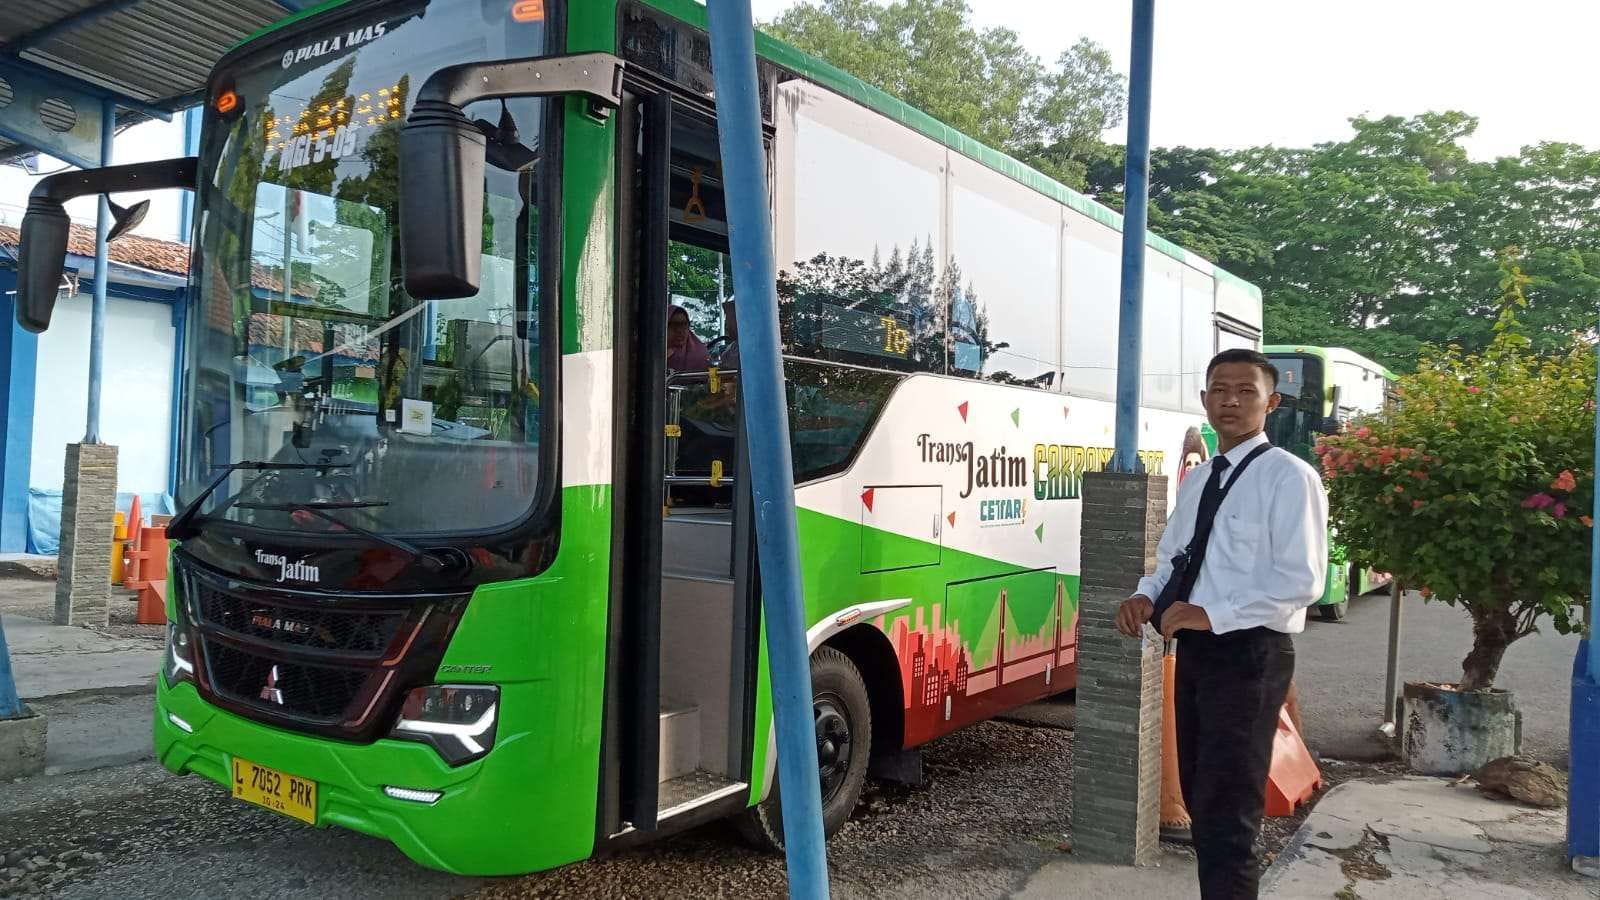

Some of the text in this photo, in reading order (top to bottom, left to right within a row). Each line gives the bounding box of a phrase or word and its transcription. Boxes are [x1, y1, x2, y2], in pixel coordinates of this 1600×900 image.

[294, 20, 388, 64] PIALA MAS
[916, 433, 962, 465] Trans
[959, 440, 1027, 499] Jatim
[255, 549, 320, 582] Trans Jatim
[235, 761, 313, 809] L 7052 PRK
